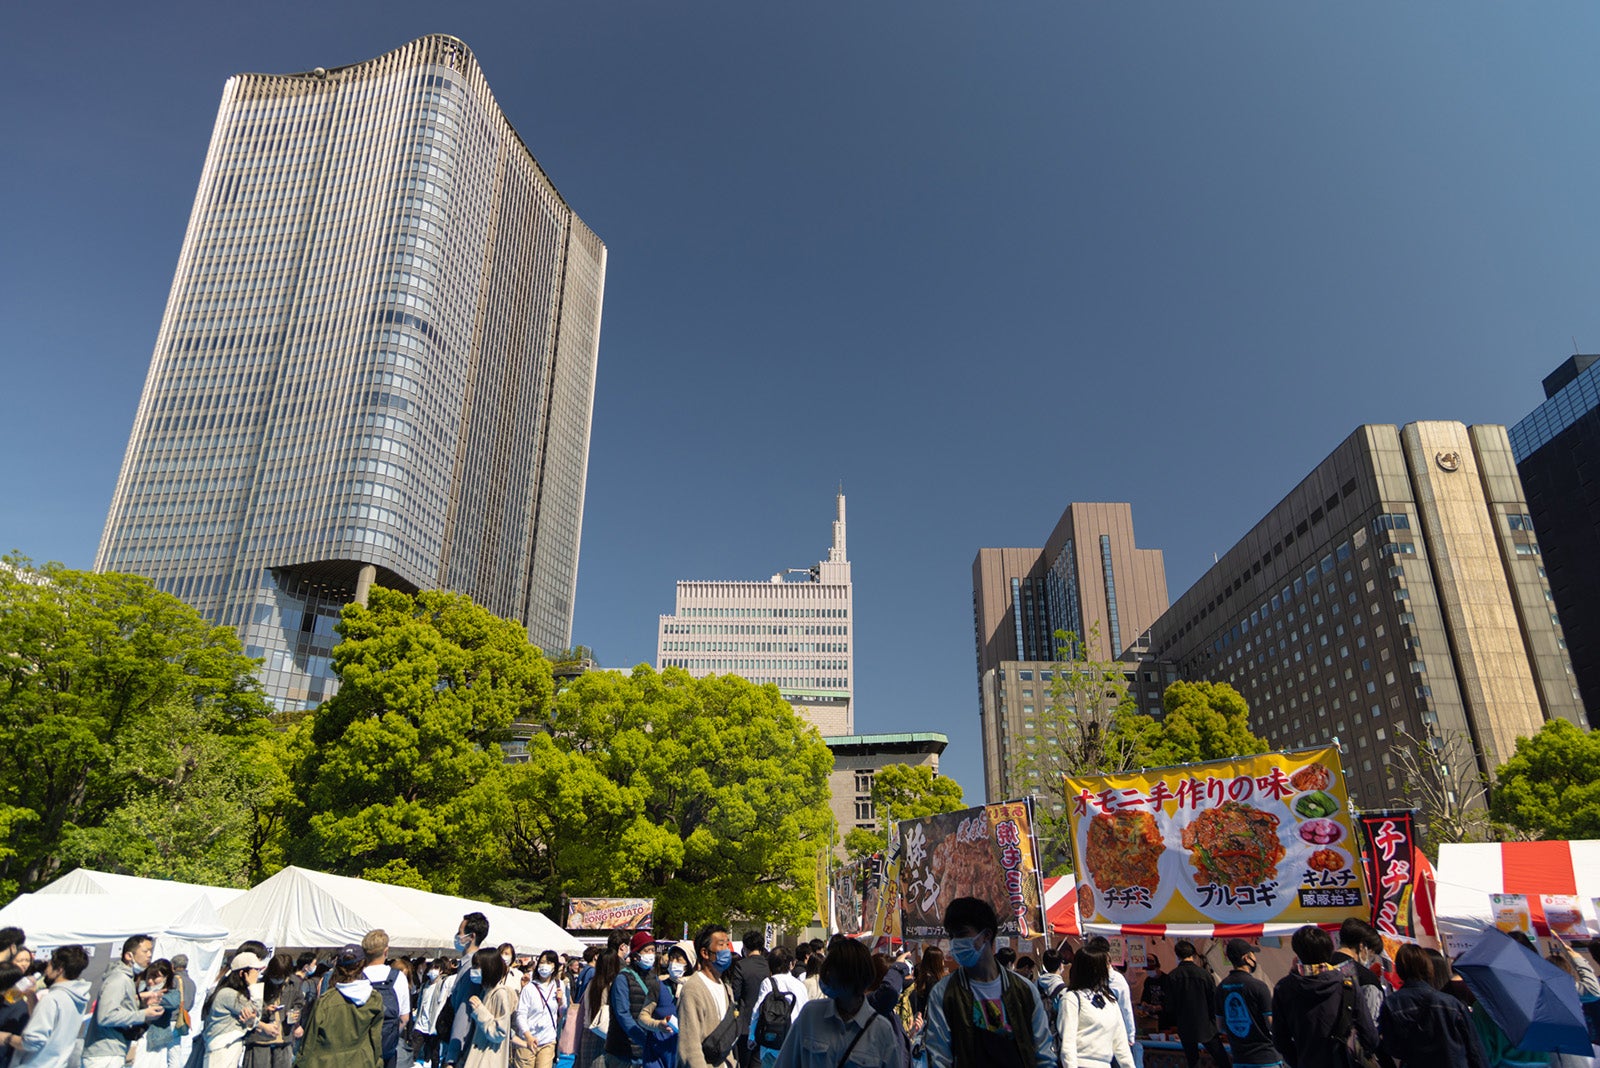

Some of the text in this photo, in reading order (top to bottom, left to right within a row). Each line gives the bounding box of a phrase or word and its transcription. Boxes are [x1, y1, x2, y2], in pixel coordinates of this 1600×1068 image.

[1073, 767, 1294, 817] オモニ手作りの味
[1302, 868, 1357, 887] キムチ
[1375, 820, 1409, 937] チヂミ
[1103, 886, 1153, 909] チヂミ
[1196, 881, 1279, 908] プルコギ
[1302, 893, 1359, 906] 豚豚拍子
[584, 914, 608, 924] LONG
[609, 907, 644, 920] POTATO
